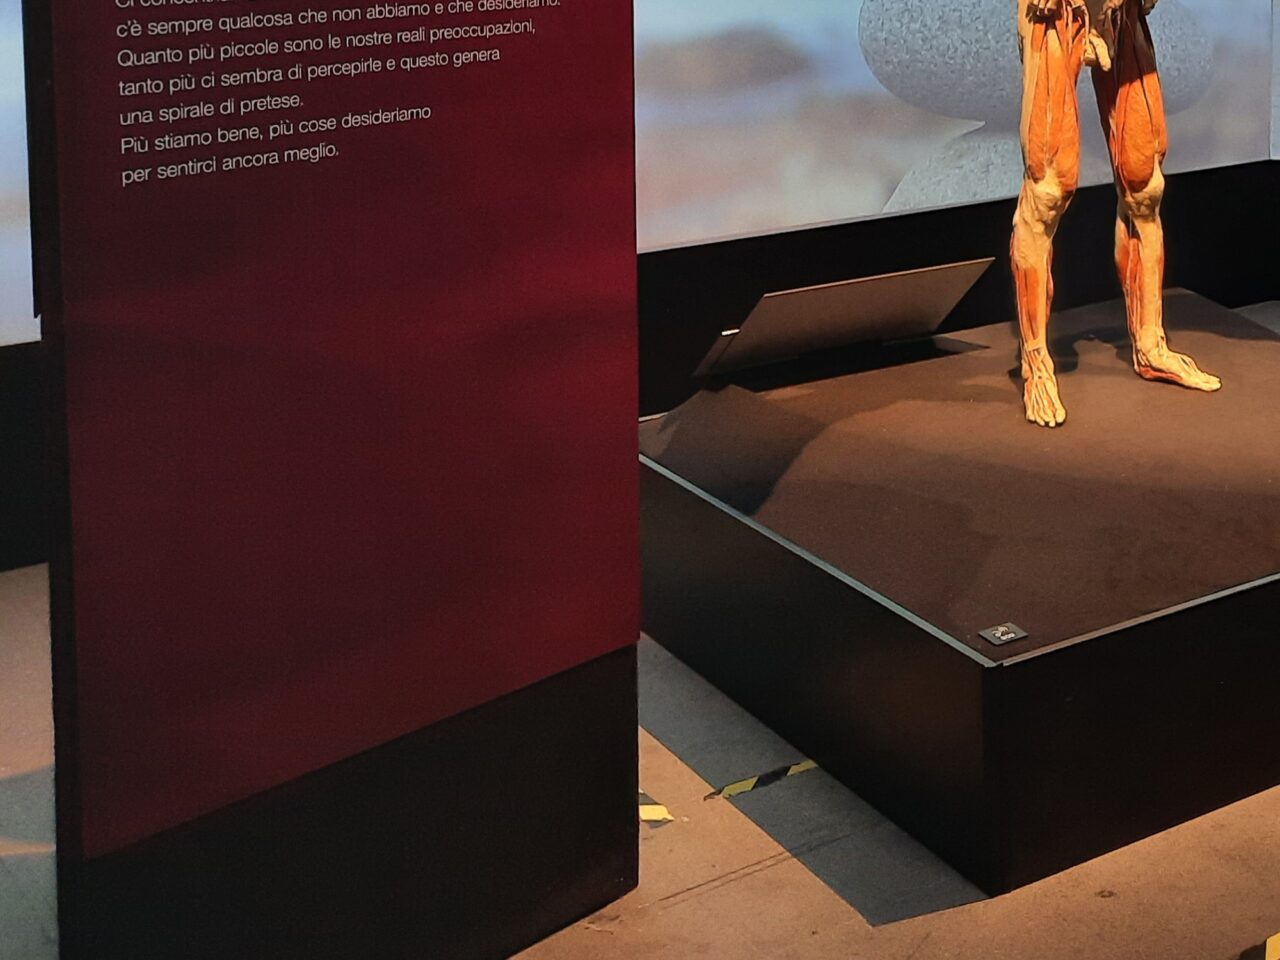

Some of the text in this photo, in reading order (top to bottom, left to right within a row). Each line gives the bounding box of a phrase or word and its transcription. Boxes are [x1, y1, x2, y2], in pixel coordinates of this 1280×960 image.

[147, 18, 213, 36] sempre
[218, 12, 293, 32] qualcosa
[298, 8, 327, 24] che
[332, 8, 361, 21] non
[366, 2, 430, 19] abbiamo
[435, 3, 444, 14] e
[117, 18, 535, 67] Quanto più piccole sono le nostre reali preoccupazioni,
[118, 49, 500, 96] tanto più ci sembra di percepirle e questo genera
[120, 95, 304, 125] una spirale di pretese.
[121, 107, 431, 154] Più stiamo bene, più cose desideriamo
[122, 142, 339, 187] per sentirci ancora meglio.
